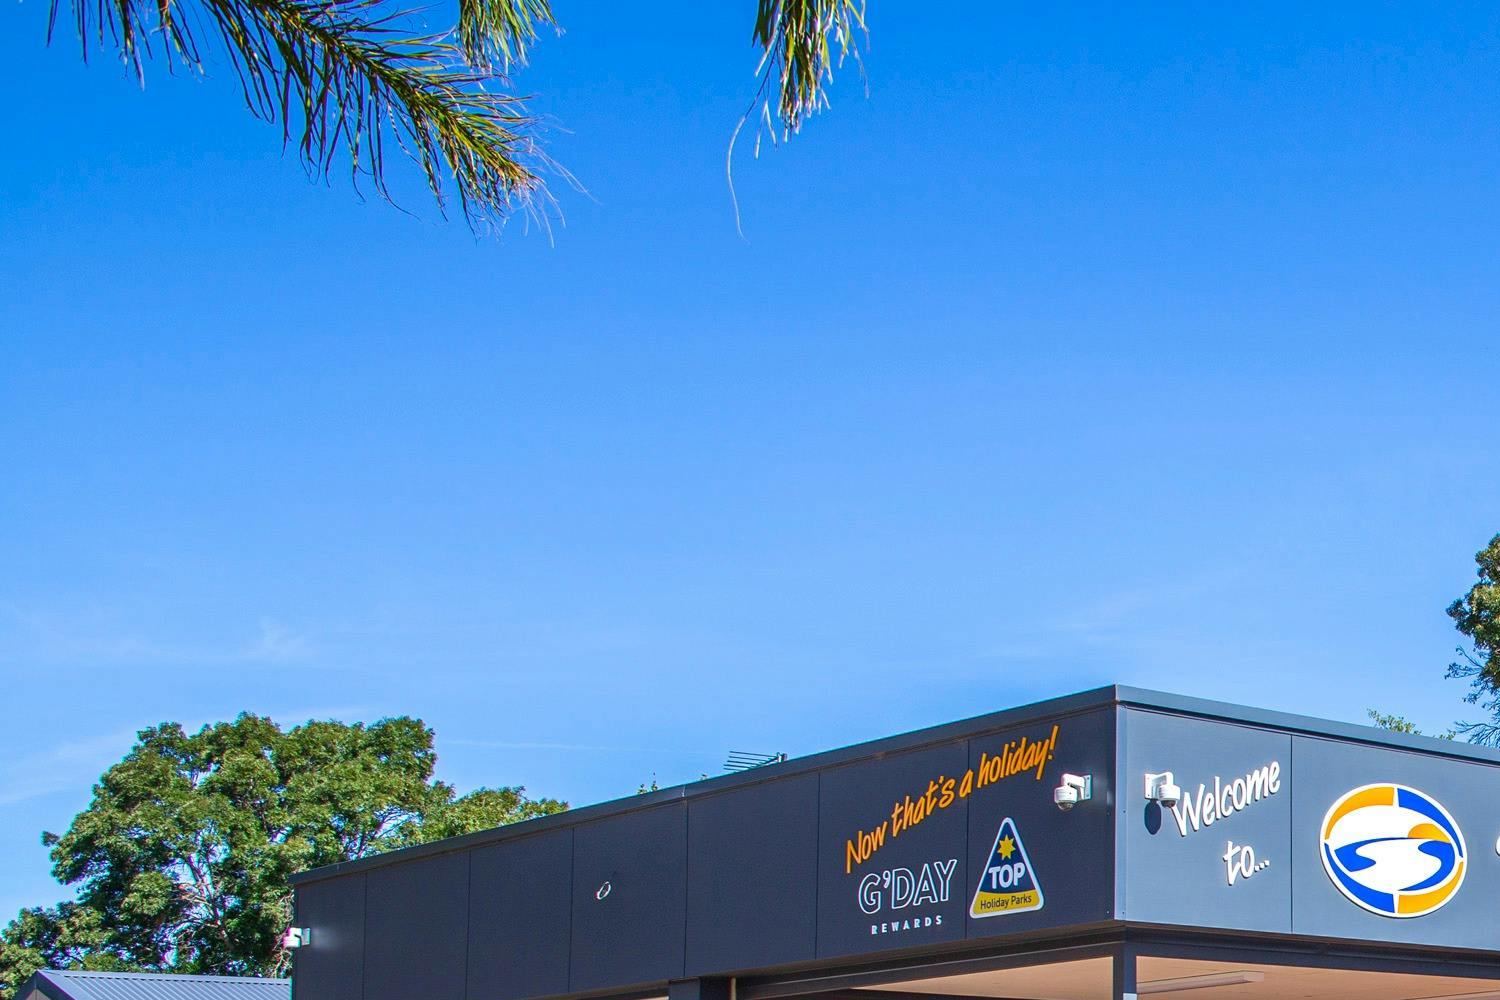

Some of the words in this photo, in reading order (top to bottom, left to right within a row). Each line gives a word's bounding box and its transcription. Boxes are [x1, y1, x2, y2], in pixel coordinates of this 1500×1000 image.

[846, 821, 888, 874] Now
[891, 775, 956, 837] that's
[959, 769, 974, 798] a
[976, 725, 1060, 789] holiday!
[1171, 761, 1281, 837] Welcome
[988, 862, 1026, 889] TOP
[980, 898, 1009, 910] Holiday
[1010, 894, 1032, 906] Parks
[871, 914, 942, 935] REWARDS
